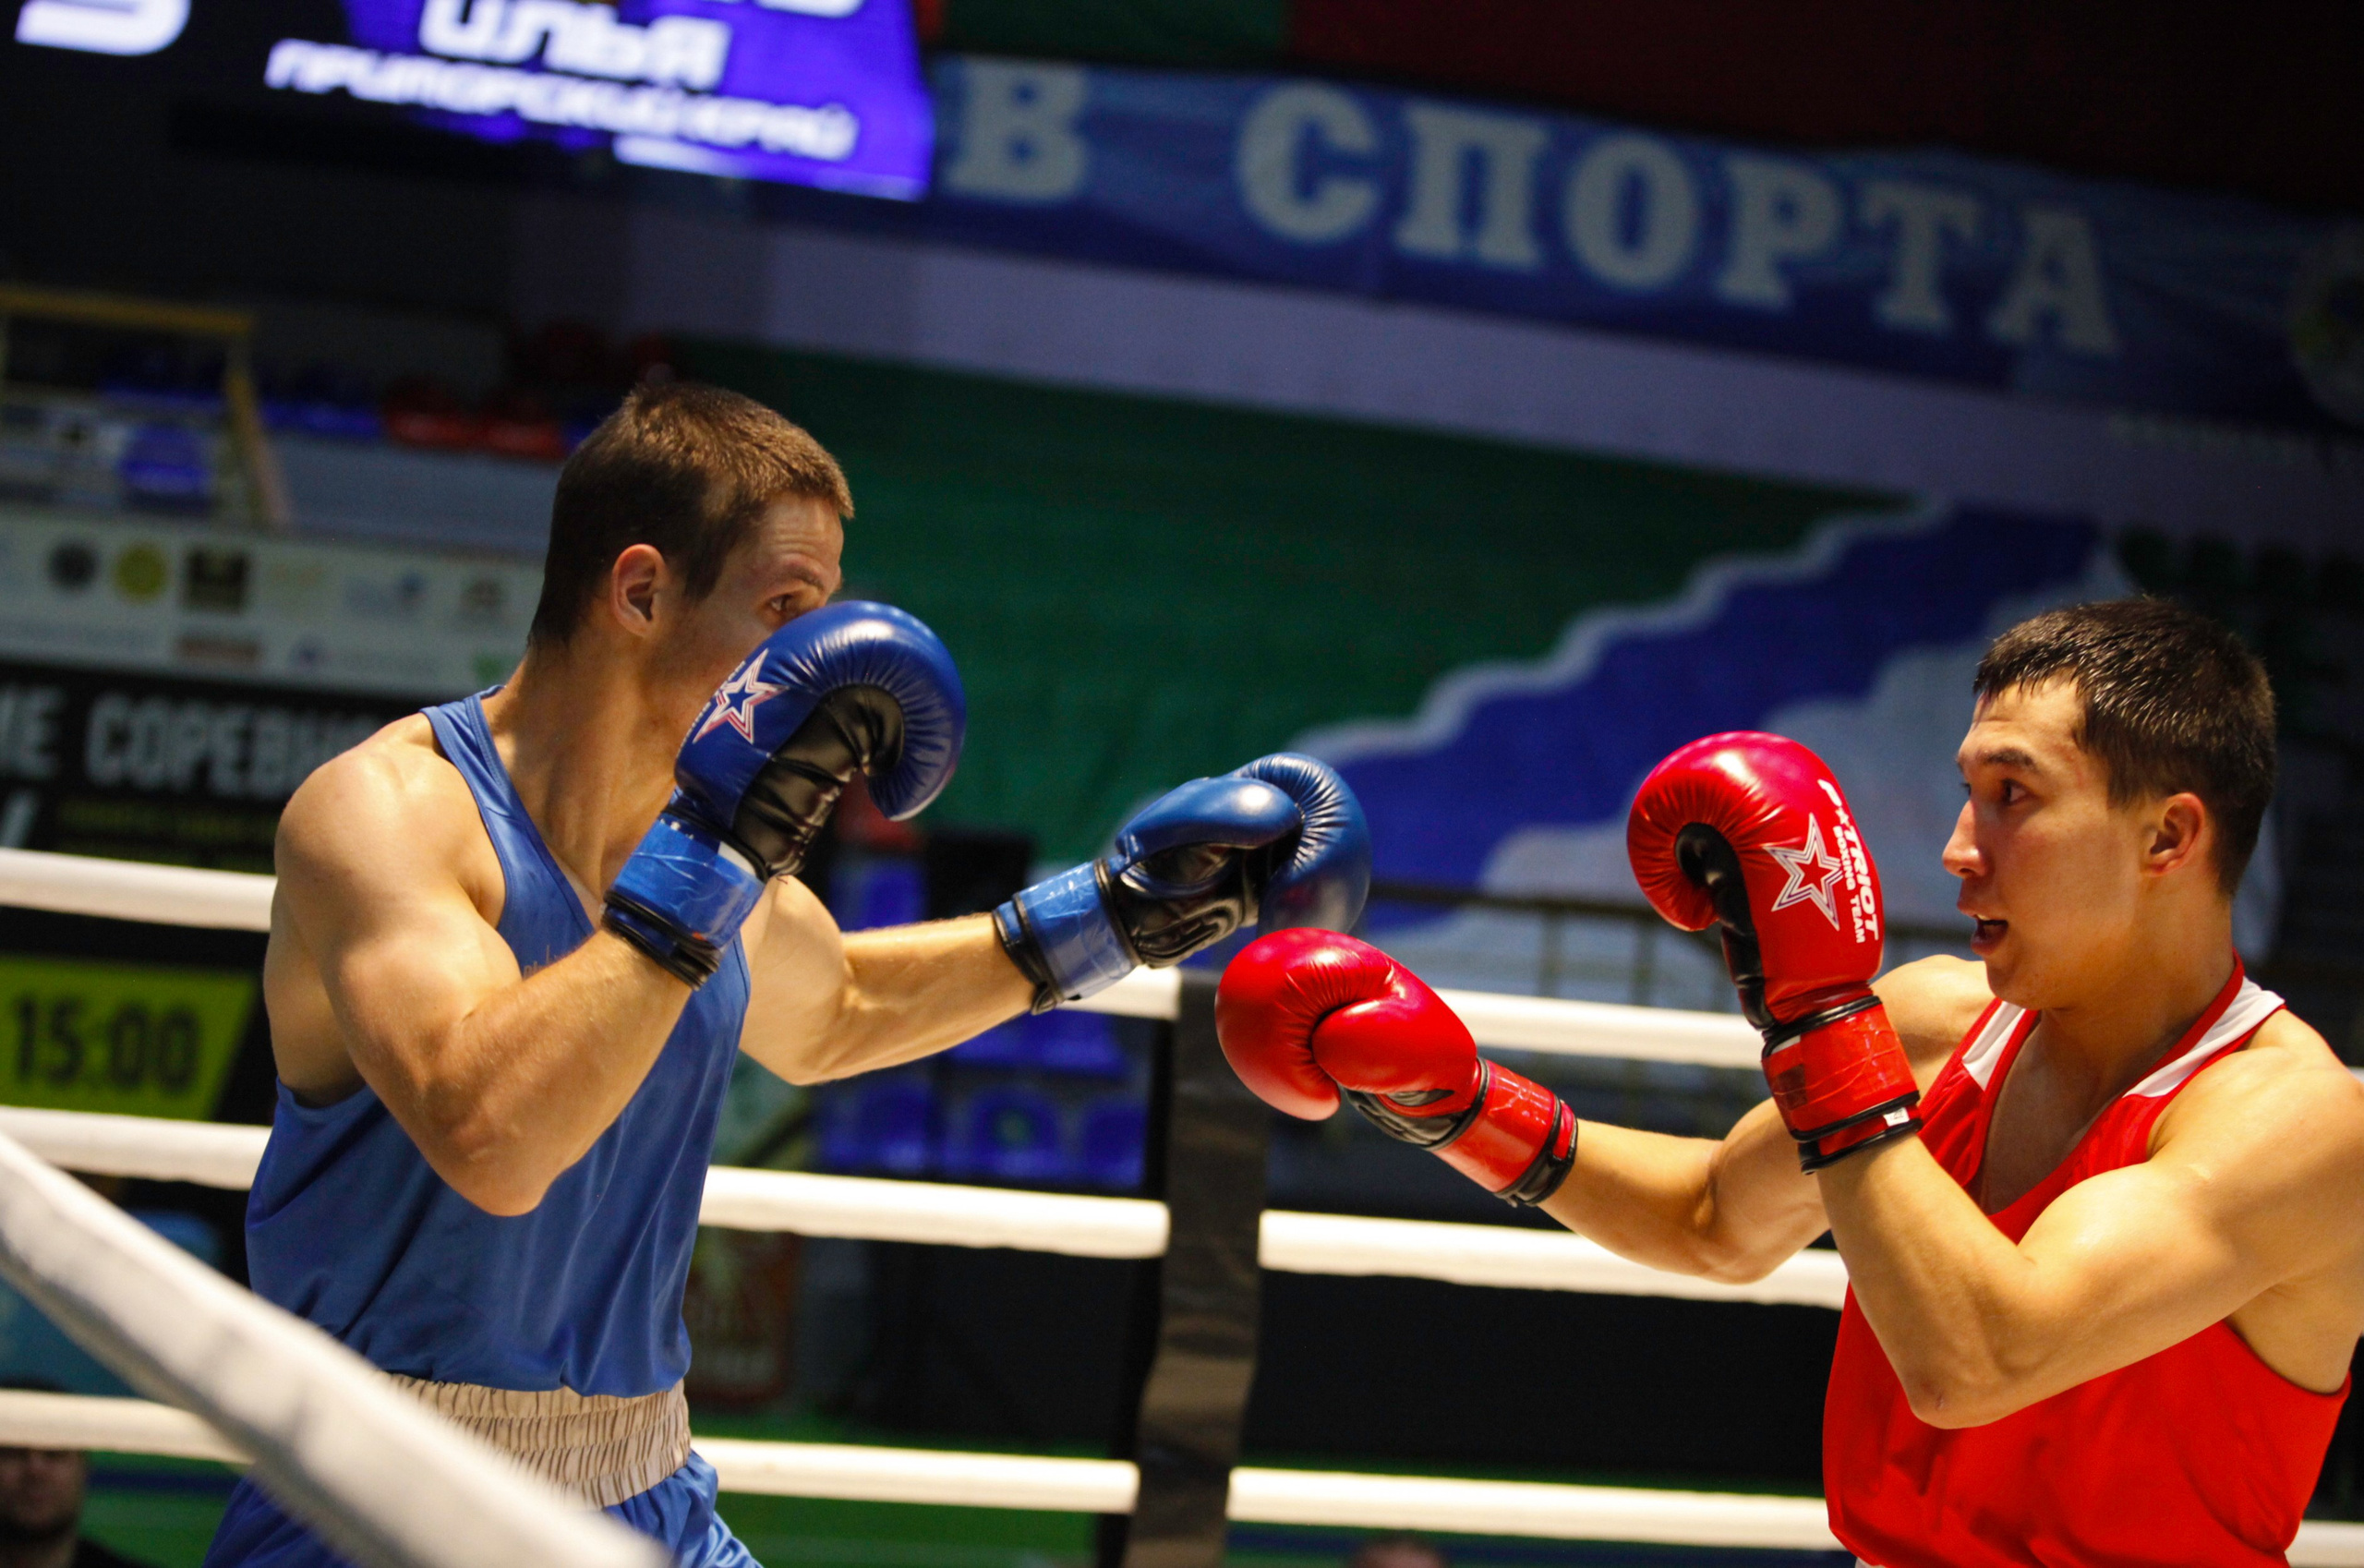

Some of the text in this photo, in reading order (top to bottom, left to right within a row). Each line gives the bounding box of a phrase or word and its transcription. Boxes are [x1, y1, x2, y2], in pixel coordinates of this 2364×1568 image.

[418, 0, 731, 90] ИЛЬЯ
[1233, 78, 2122, 356] СПОРТА
[1832, 826, 1866, 944] BOXING TEAM
[12, 992, 202, 1099] 15:00
